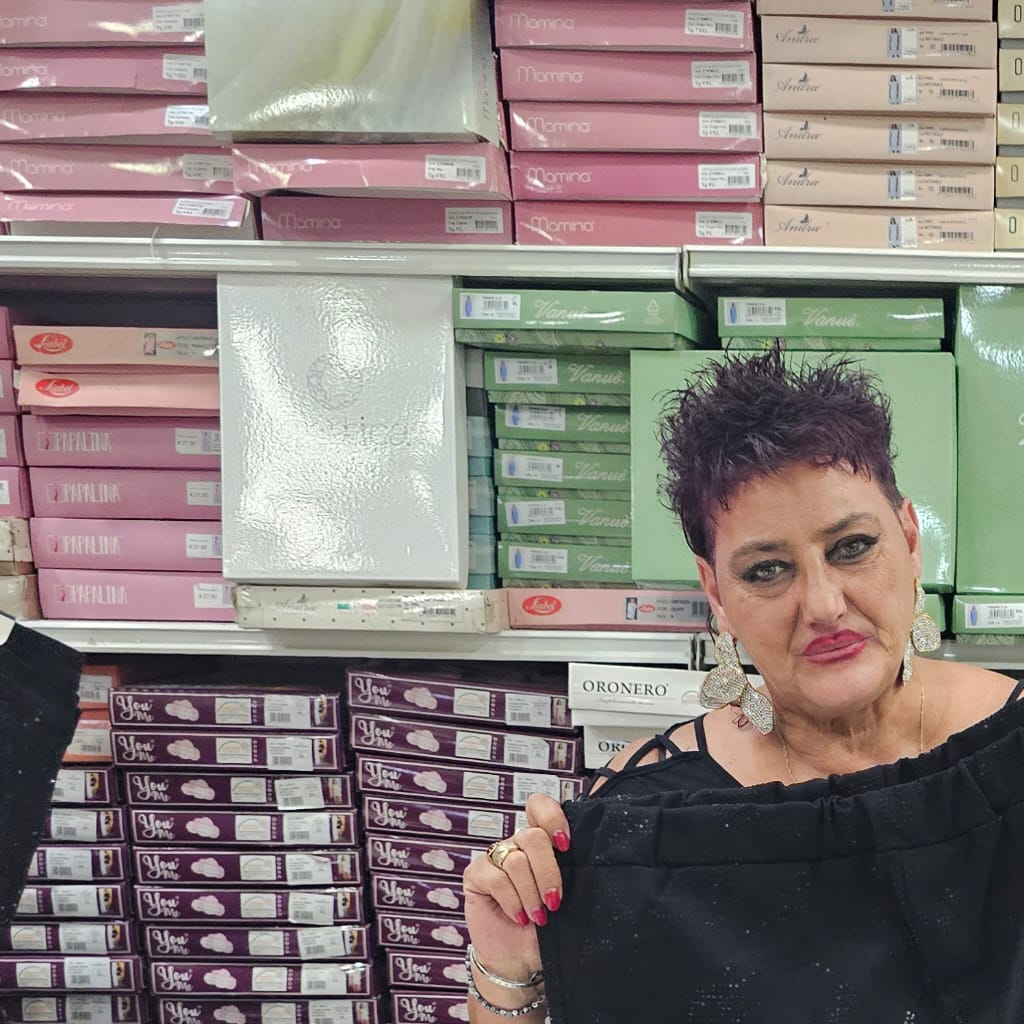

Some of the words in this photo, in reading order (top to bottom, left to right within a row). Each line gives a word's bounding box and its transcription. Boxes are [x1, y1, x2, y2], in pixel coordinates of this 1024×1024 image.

[0, 15, 48, 28] amina
[509, 13, 574, 30] Mamina
[0, 64, 48, 76] amina
[517, 66, 584, 83] Mamina
[6, 109, 65, 123] Mamina
[526, 118, 591, 134] Mamina
[10, 160, 73, 175] Mamina
[528, 167, 591, 184] Mamina
[278, 213, 341, 229] Mamina
[531, 217, 594, 234] Mamina
[802, 307, 857, 327] Vanuè
[568, 364, 623, 385] Vanuè
[576, 413, 631, 433] Vanuè
[54, 432, 112, 451] PAPALINA
[574, 462, 628, 482] Vanuè
[62, 483, 120, 503] PAPALINA
[62, 536, 120, 554] PAPALINA
[70, 585, 128, 604] PAPALINA
[354, 678, 392, 703] You
[583, 680, 667, 696] ORONERO
[116, 696, 152, 720] You
[358, 720, 394, 745] You
[119, 736, 155, 760] You
[365, 762, 401, 786] You
[133, 776, 169, 800] You
[370, 801, 408, 825] You
[138, 814, 174, 838] You
[374, 841, 410, 865] You
[142, 855, 179, 879] You
[380, 880, 415, 904] You
[143, 892, 179, 916] You
[384, 918, 420, 942] You
[152, 930, 188, 953] You
[157, 966, 192, 990] You
[395, 957, 431, 981] You
[166, 1002, 201, 1024] You
[400, 998, 436, 1021] You
